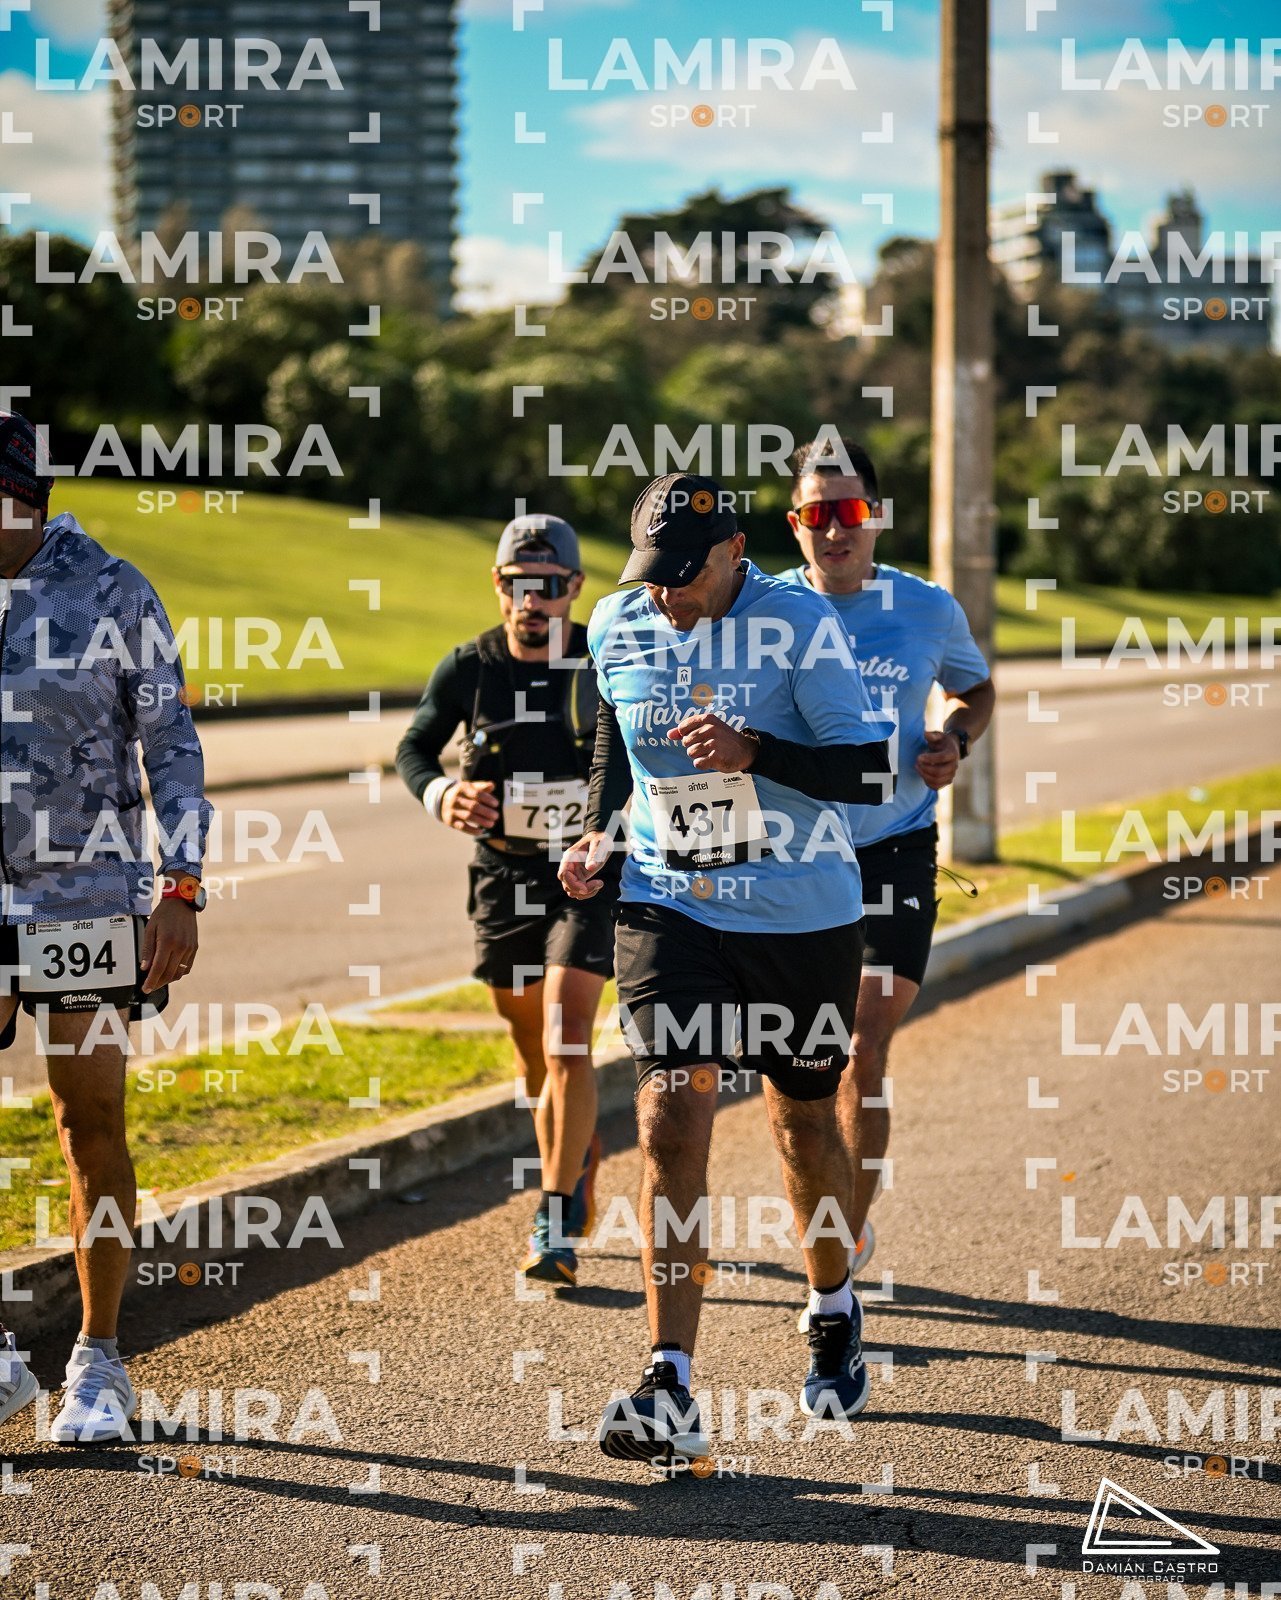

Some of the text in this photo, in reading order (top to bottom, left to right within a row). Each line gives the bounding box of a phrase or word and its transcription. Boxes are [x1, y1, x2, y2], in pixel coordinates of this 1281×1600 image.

[521, 802, 582, 830] 732
[669, 798, 734, 840] 437
[72, 920, 94, 931] antel
[42, 940, 117, 980] 394
[60, 993, 103, 1005] Maratón
[792, 1055, 834, 1068] EXPERT
